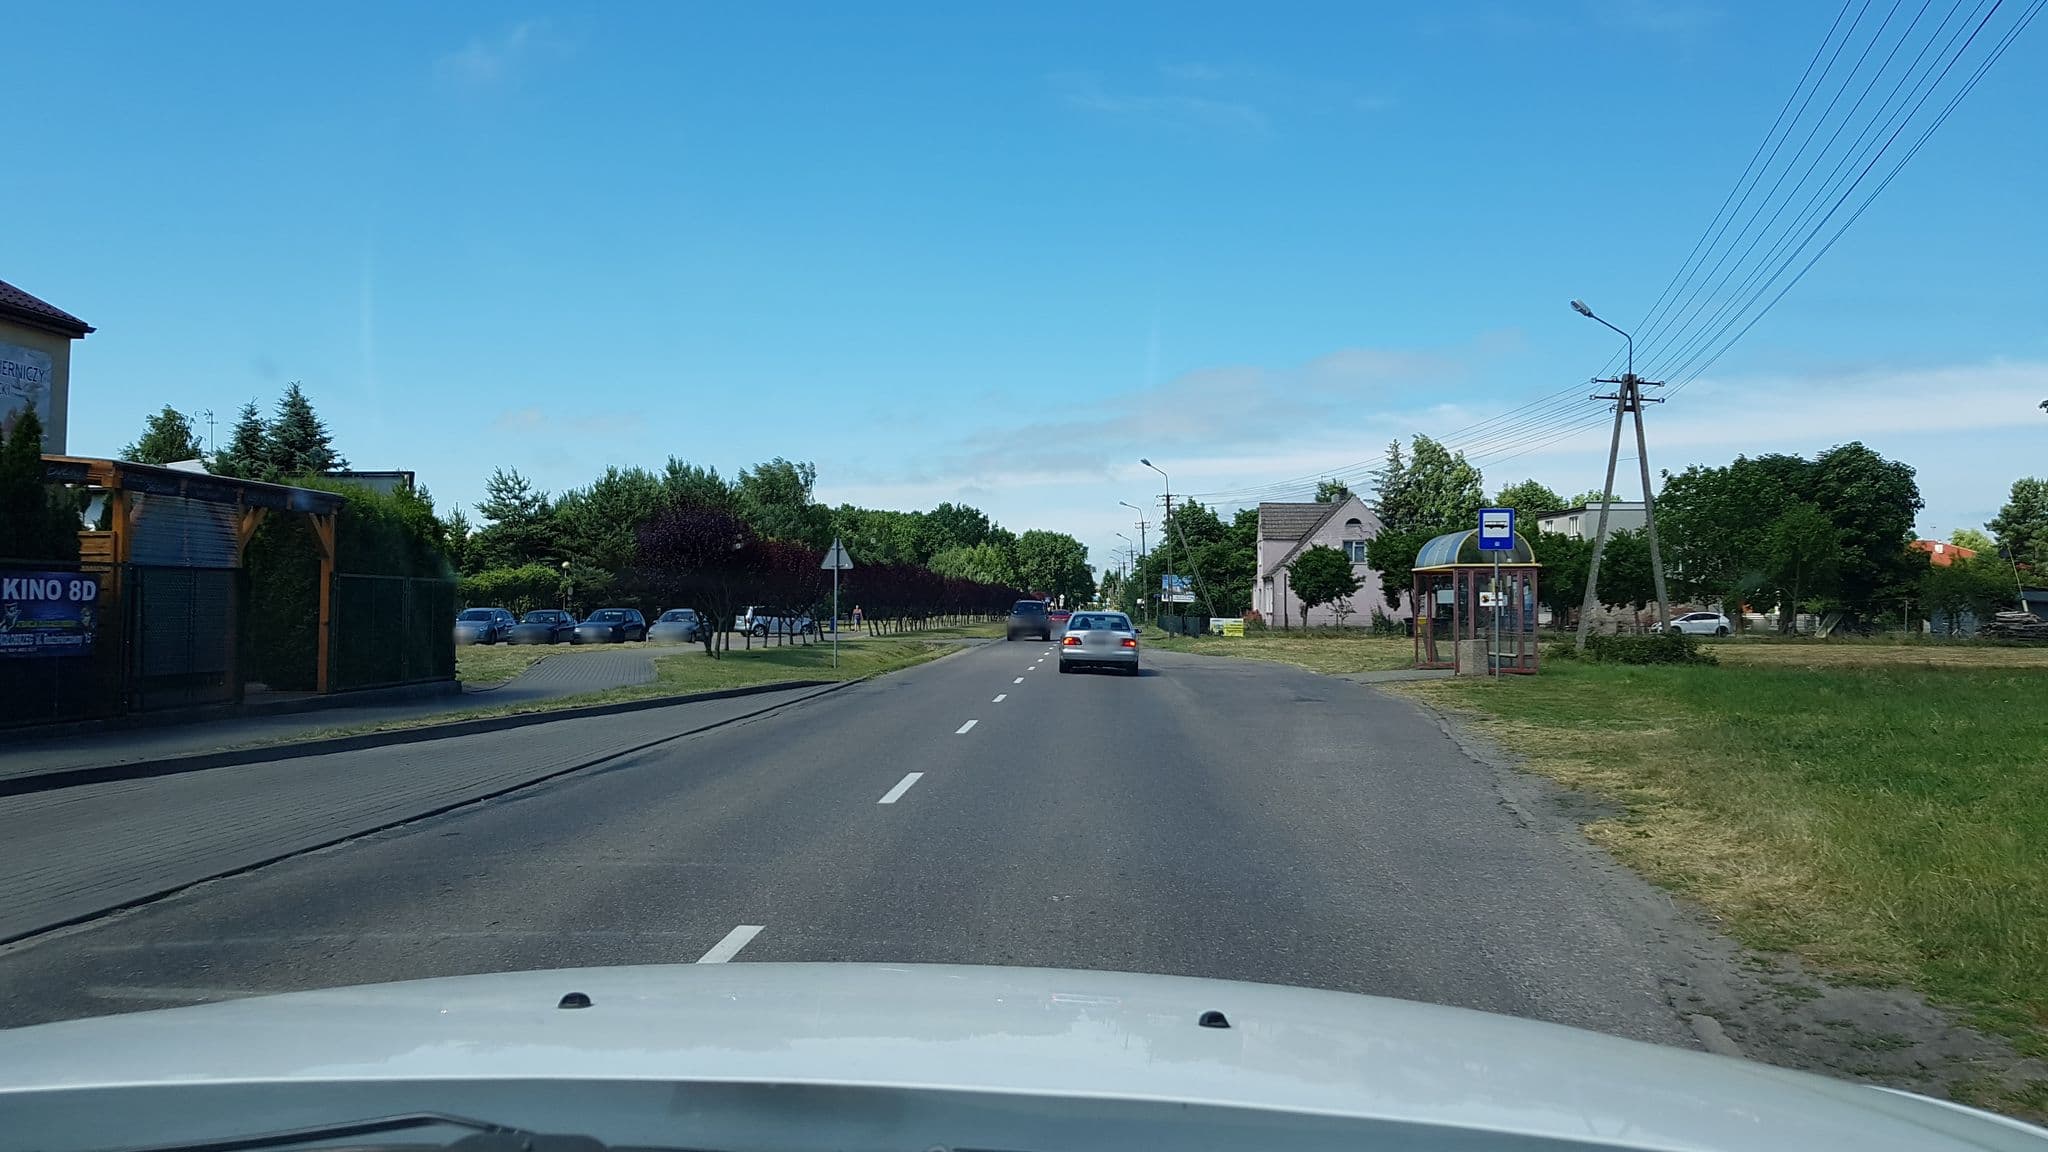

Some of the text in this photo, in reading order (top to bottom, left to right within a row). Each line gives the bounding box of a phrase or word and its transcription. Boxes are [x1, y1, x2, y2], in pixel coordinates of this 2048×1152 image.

[0, 360, 45, 383] ERNICZY
[2, 578, 97, 601] KINO 8D
